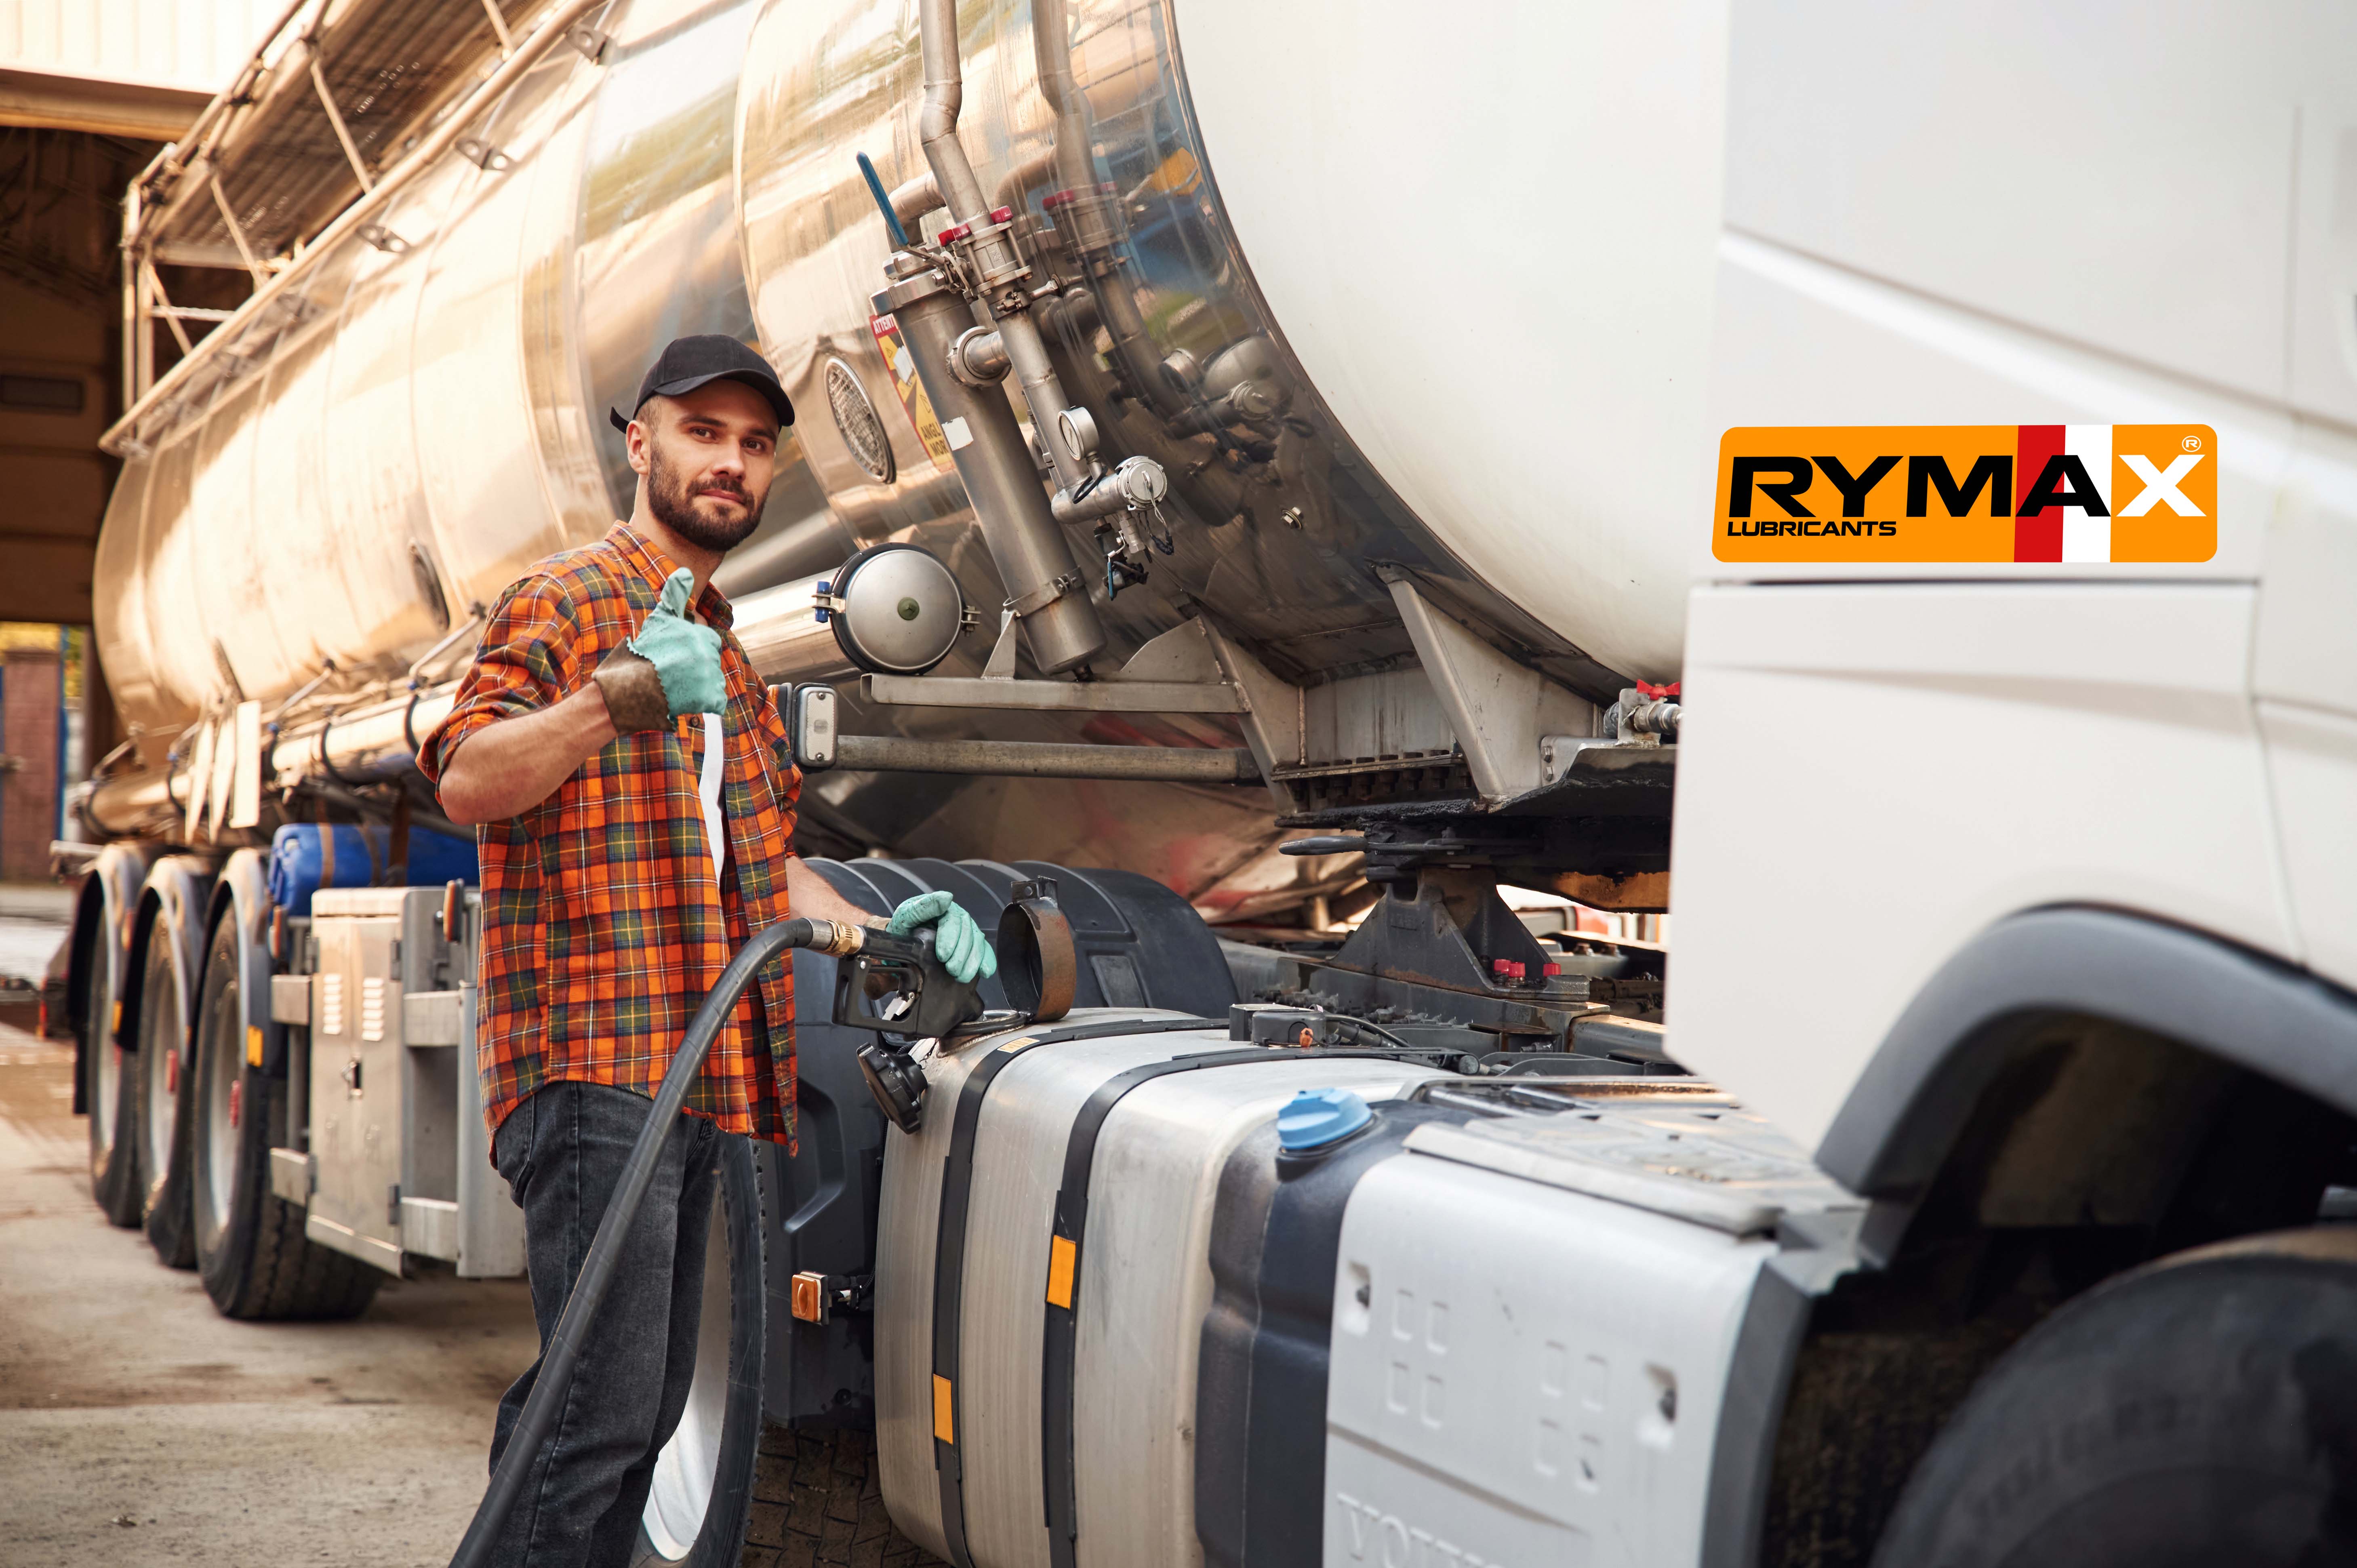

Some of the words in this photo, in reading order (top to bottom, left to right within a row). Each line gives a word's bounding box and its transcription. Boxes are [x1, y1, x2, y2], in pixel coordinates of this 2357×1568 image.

[920, 421, 941, 440] ANGL
[930, 439, 949, 456] MOR
[1729, 455, 2206, 517] RYMAX
[1728, 522, 1896, 536] LUBRICANTS
